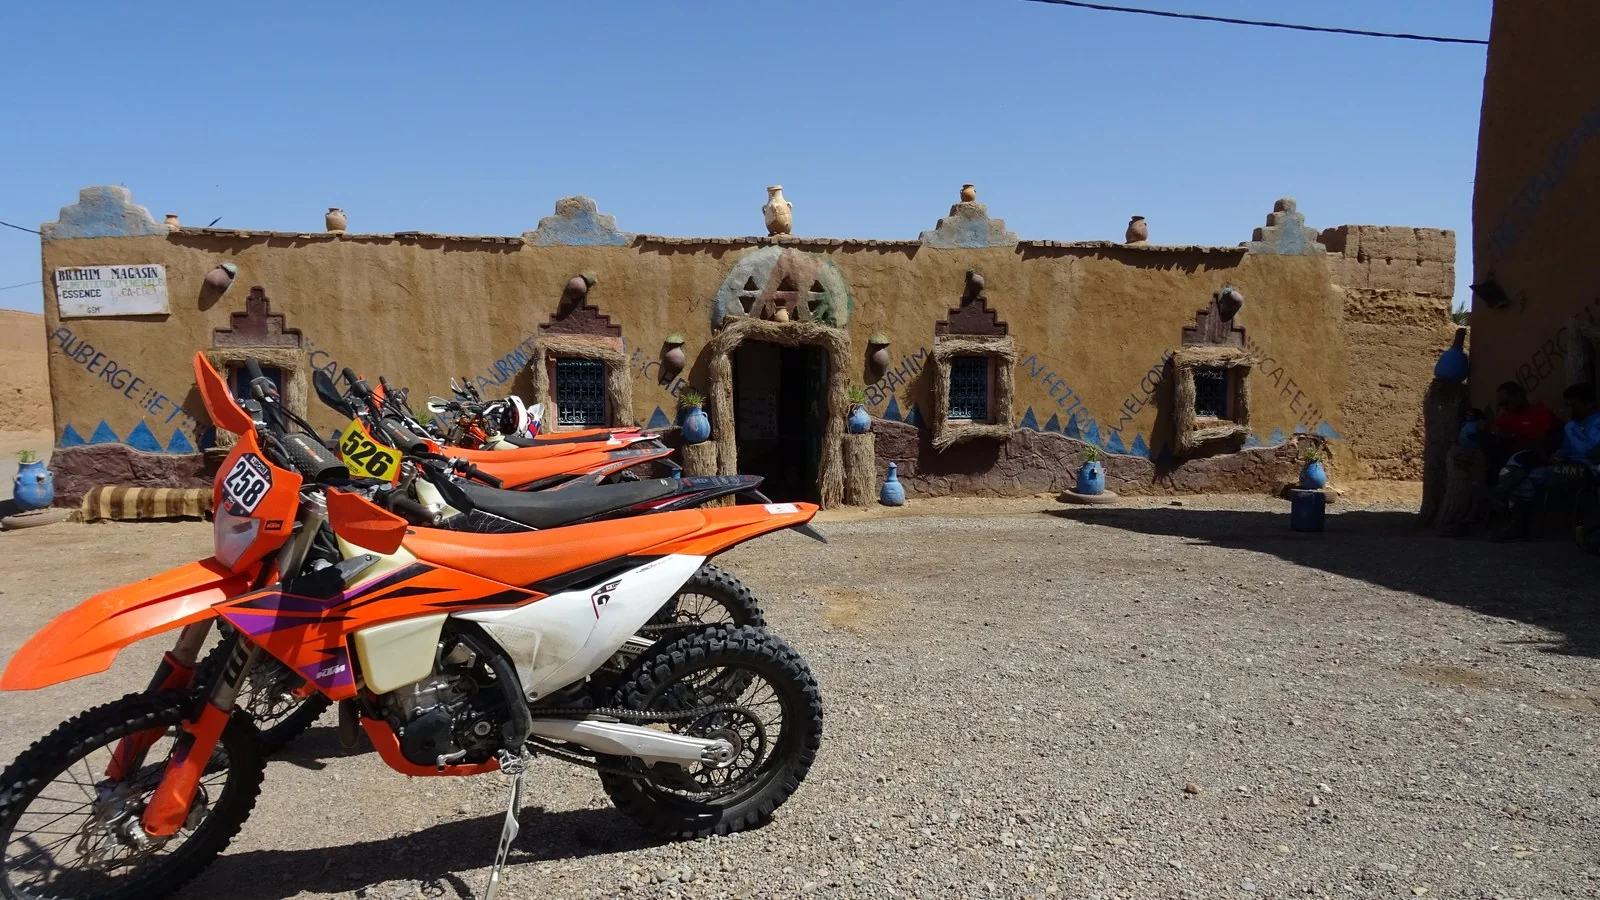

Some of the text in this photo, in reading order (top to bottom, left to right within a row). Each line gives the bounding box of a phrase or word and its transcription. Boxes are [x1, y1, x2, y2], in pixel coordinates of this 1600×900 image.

[62, 288, 102, 299] ESSENCE
[111, 266, 158, 279] MAGASIN
[50, 327, 183, 424] AUBERGE ET
[864, 346, 929, 406] BRAHIM
[1258, 357, 1307, 415] CAFE
[341, 429, 394, 477] 526
[225, 460, 266, 508] 258
[315, 664, 346, 680] KTM
